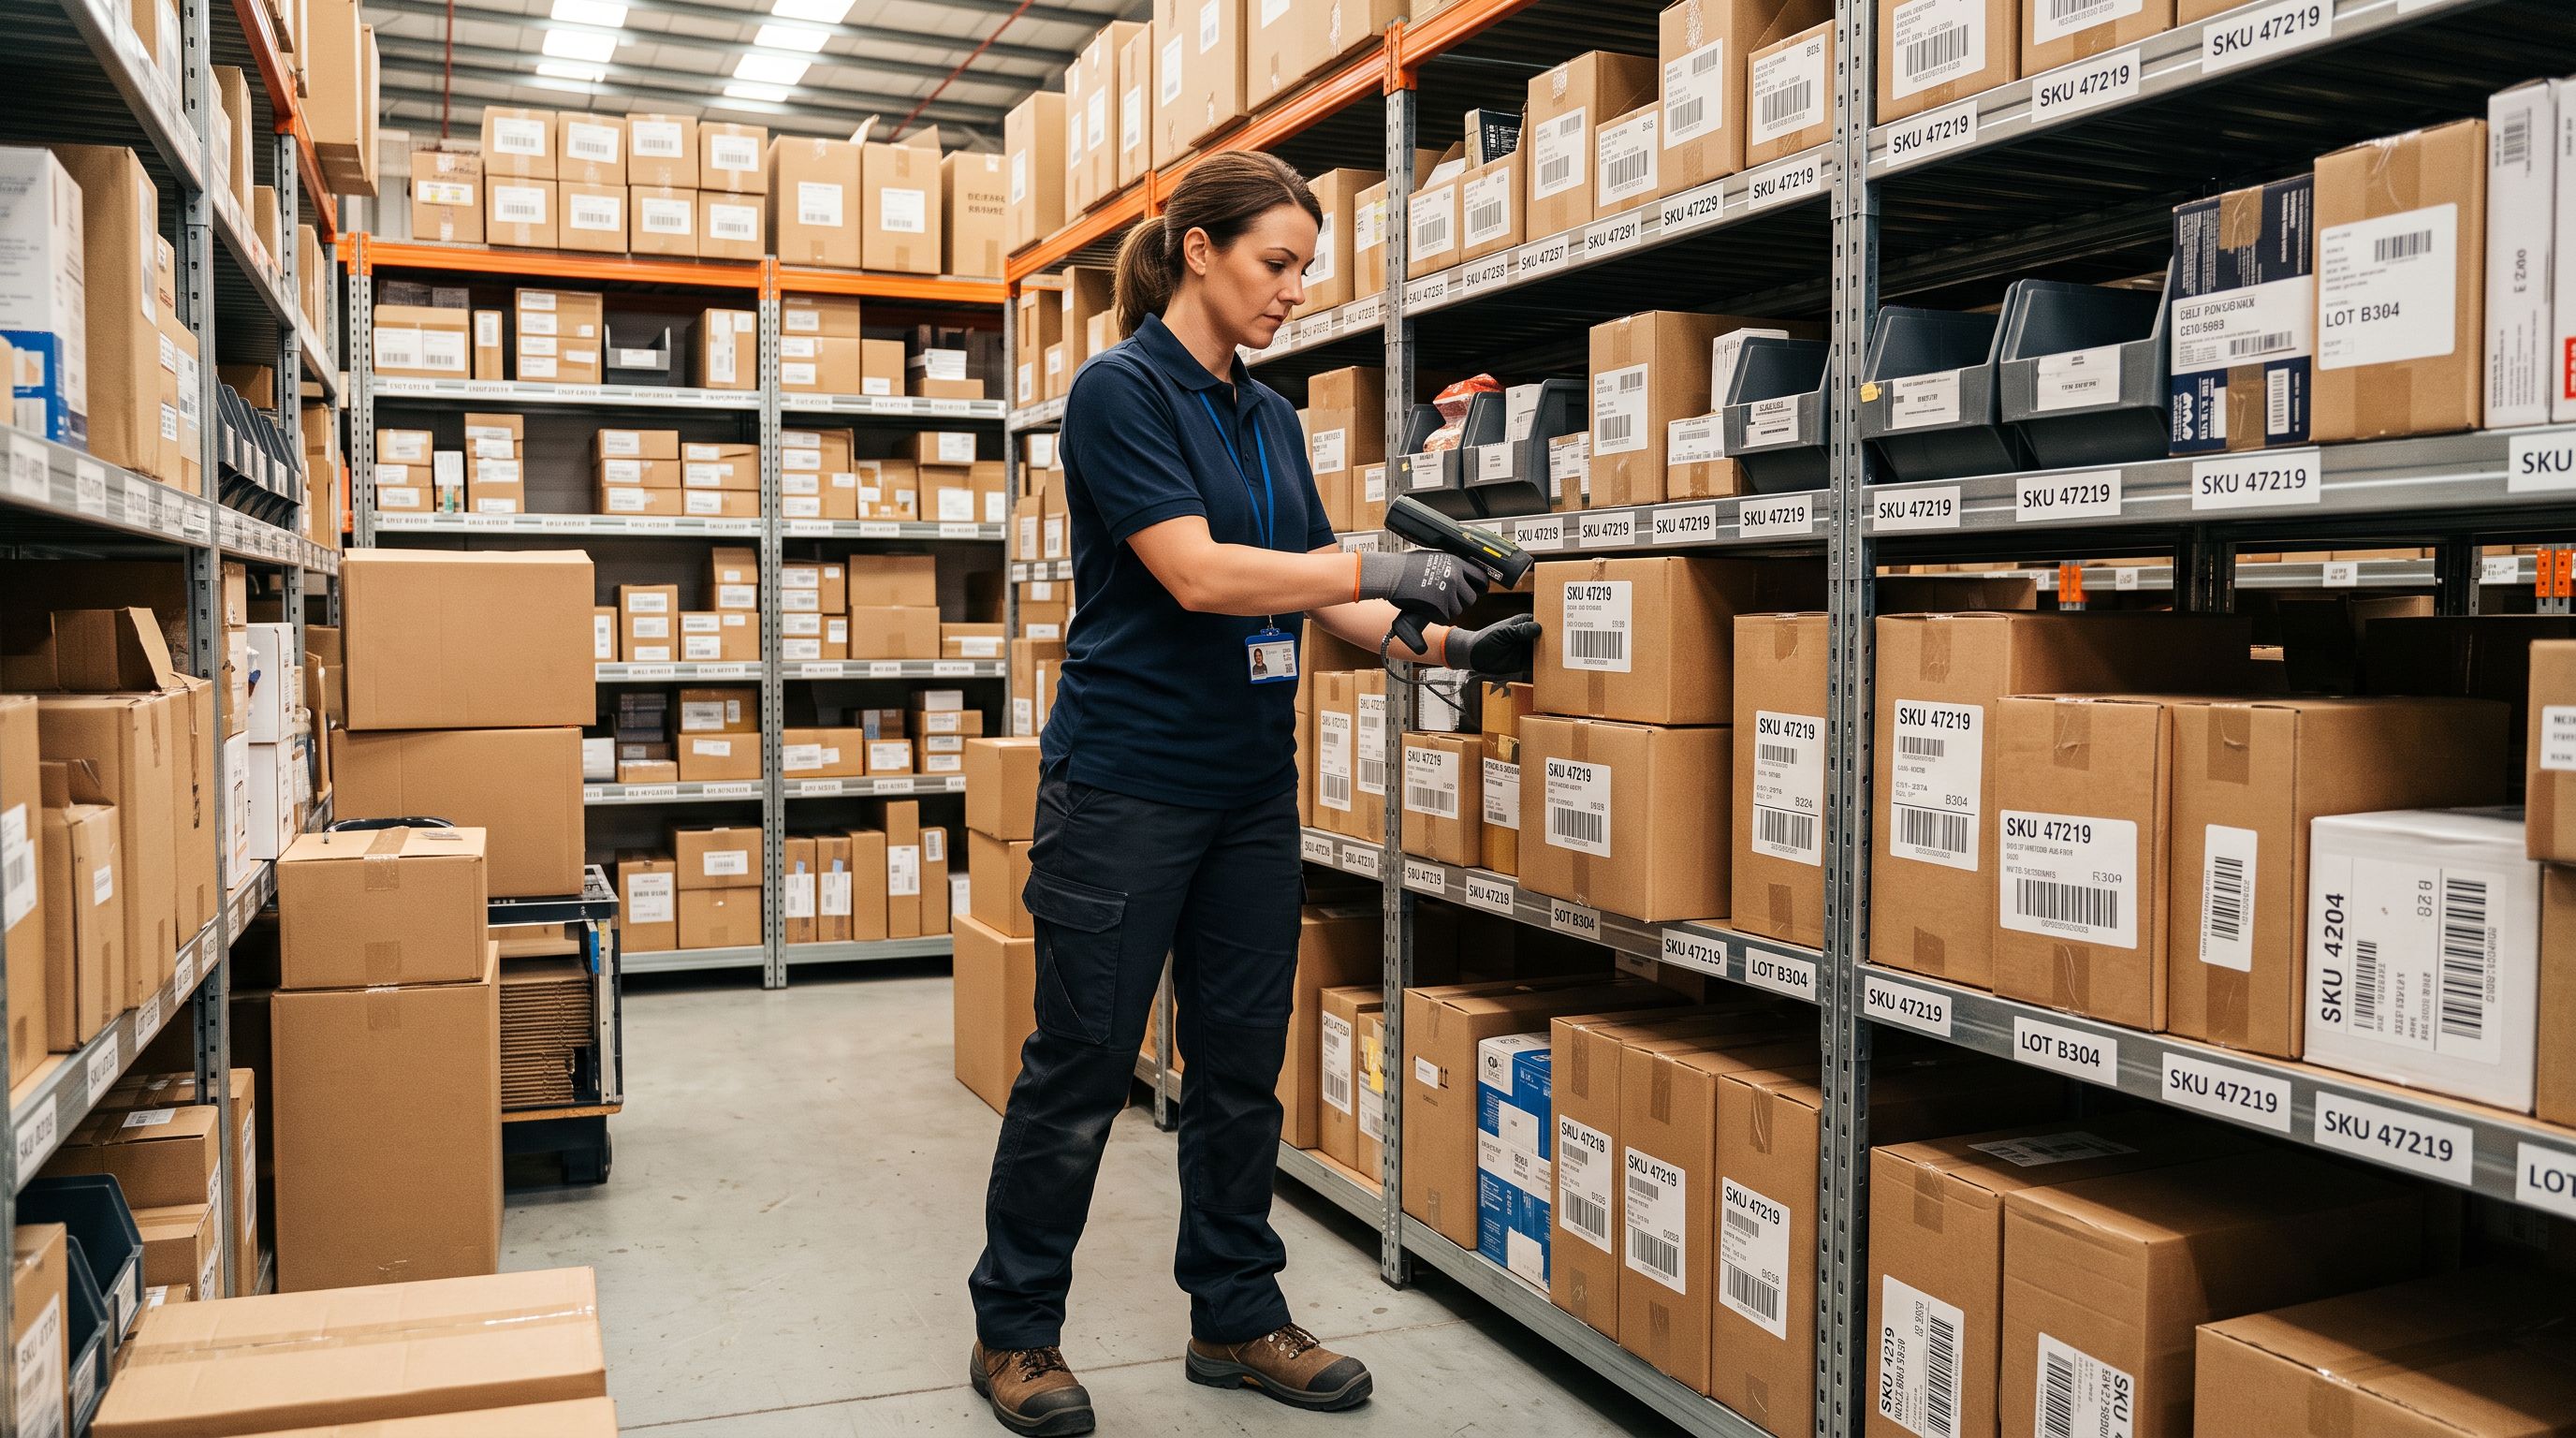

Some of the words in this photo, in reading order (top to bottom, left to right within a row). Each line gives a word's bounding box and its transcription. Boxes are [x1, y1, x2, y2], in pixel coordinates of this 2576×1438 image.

[2213, 26, 2252, 55] SKU
[2261, 6, 2320, 42] 47219
[2041, 81, 2074, 108] SKU
[2080, 66, 2129, 95] 47219
[1894, 129, 1921, 154] SKU
[1926, 115, 1968, 142] 47219
[1754, 179, 1775, 198] SKU
[1779, 168, 1813, 190] 47219
[1665, 207, 1683, 226] SKU
[1688, 196, 1717, 217] 47229
[1588, 232, 1605, 249] SKU
[1609, 223, 1634, 242] 47291
[2326, 309, 2355, 328] LOT
[2523, 449, 2572, 474] SKU
[2203, 474, 2238, 494] SKU
[2246, 469, 2305, 491] 47219
[2024, 489, 2054, 507] SKU
[2060, 484, 2109, 505] 47219
[1745, 510, 1765, 526] SKU
[1769, 506, 1804, 523] 47219
[1880, 502, 1905, 519] SKU
[1910, 499, 1951, 517] 47219
[1517, 528, 1532, 542] SKU
[1583, 524, 1599, 537] SKU
[1603, 522, 1629, 536] 47219
[1657, 519, 1676, 534] SKU
[1679, 516, 1709, 531] 47219
[1568, 586, 1583, 600] SKU
[1587, 587, 1611, 600] 47219
[1760, 718, 1779, 735] SKU
[1784, 722, 1814, 740] 47219
[1900, 708, 1925, 726] SKU
[1931, 711, 1969, 729] 47219
[1549, 763, 1564, 778] SKU
[1567, 766, 1590, 782] 47219
[1946, 795, 1968, 806] B304
[2007, 817, 2037, 838] SKU
[2044, 822, 2090, 844] 47219
[1422, 871, 1441, 885] 47219
[2093, 872, 2121, 883] R309
[1470, 885, 1484, 899] SKU
[1555, 908, 1571, 924] SOT
[1573, 913, 1594, 931] B304
[2324, 894, 2344, 958] 4204
[1665, 938, 1685, 956] SKU
[1689, 945, 1720, 964] 47219
[1752, 960, 1774, 978] LOT
[1778, 966, 1808, 987] B304
[1869, 989, 1895, 1009] SKU
[1899, 998, 1942, 1023] 47219
[2321, 969, 2342, 1022] SKU
[2022, 1032, 2052, 1054] LOT
[2058, 1040, 2100, 1067] B304
[2171, 1069, 2207, 1095] SKU
[2214, 1082, 2278, 1114] 47219
[2325, 1110, 2369, 1139] SKU
[2377, 1126, 2453, 1163] 47219
[1628, 1154, 1647, 1174] SKU
[1650, 1164, 1677, 1187] 47219
[1725, 1185, 1747, 1209] SKU
[1749, 1199, 1780, 1225] 47219
[1884, 1328, 1894, 1367] 4219
[1881, 1372, 1893, 1413] SKU
[2113, 1374, 2129, 1423] SKU
